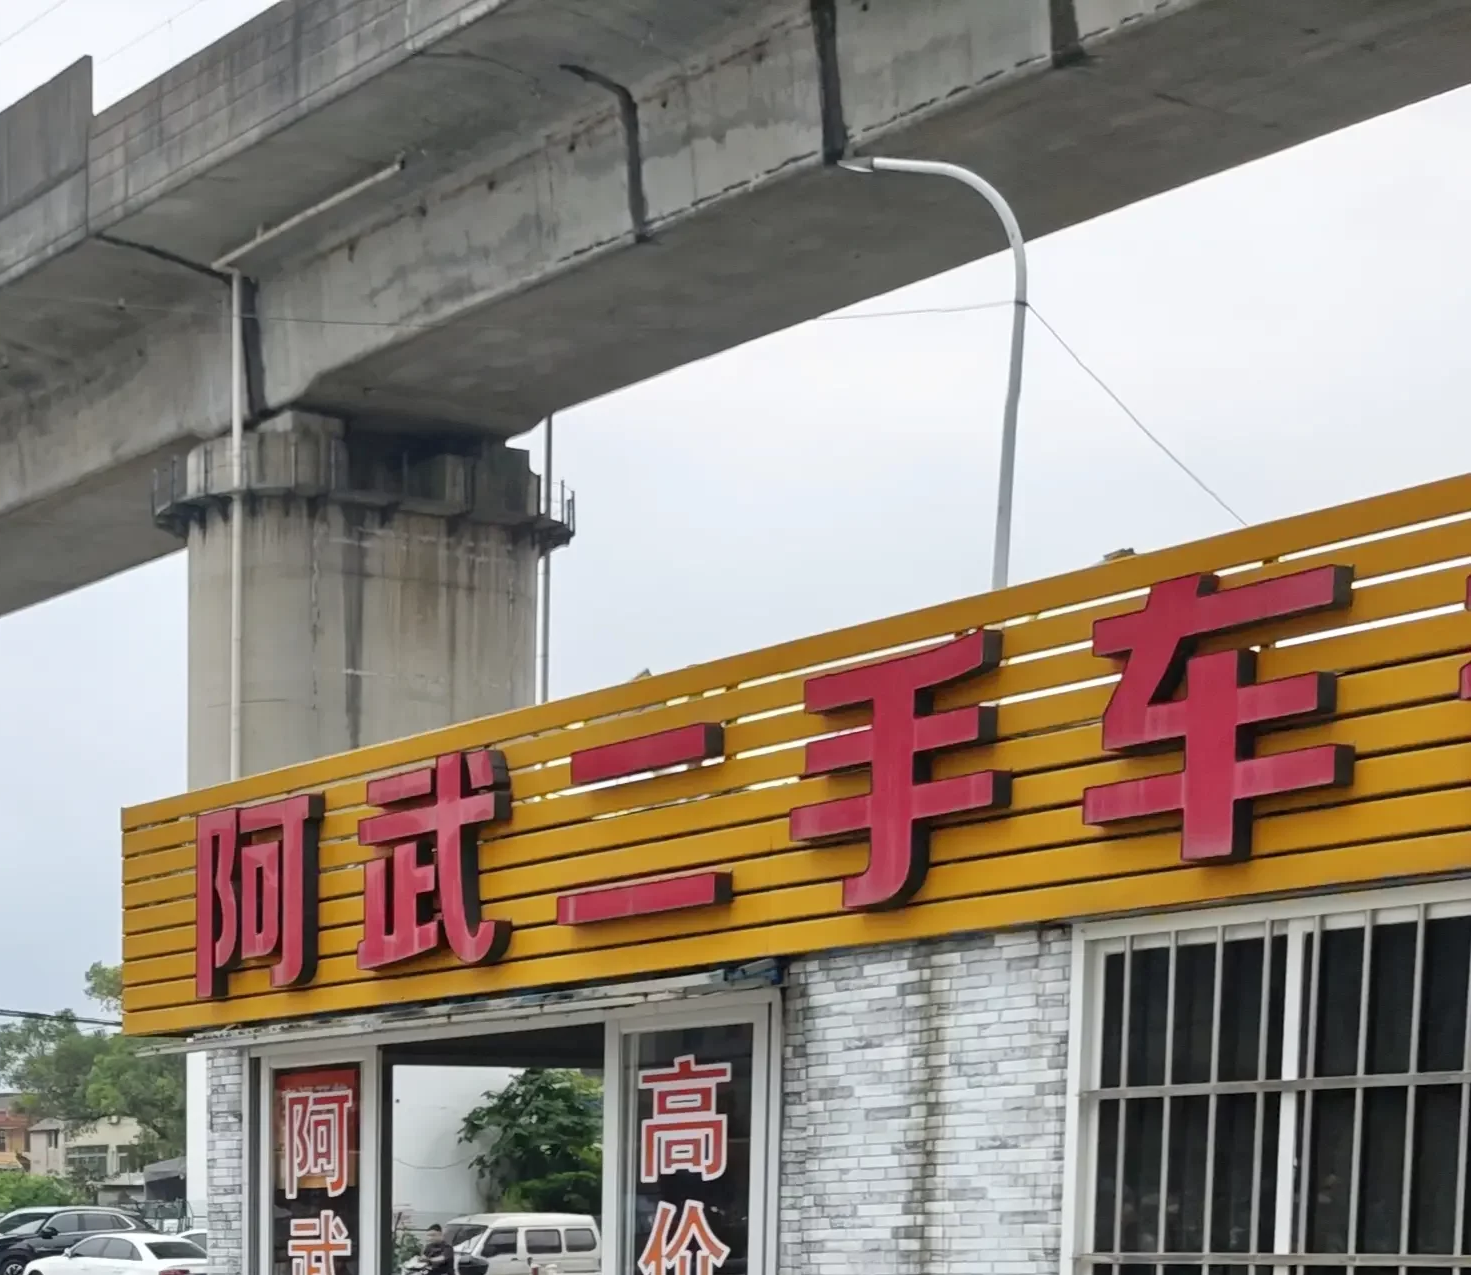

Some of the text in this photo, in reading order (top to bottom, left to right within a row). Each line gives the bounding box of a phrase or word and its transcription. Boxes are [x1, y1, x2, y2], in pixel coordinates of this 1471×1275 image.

[196, 565, 1471, 1000] 阿武二手车
